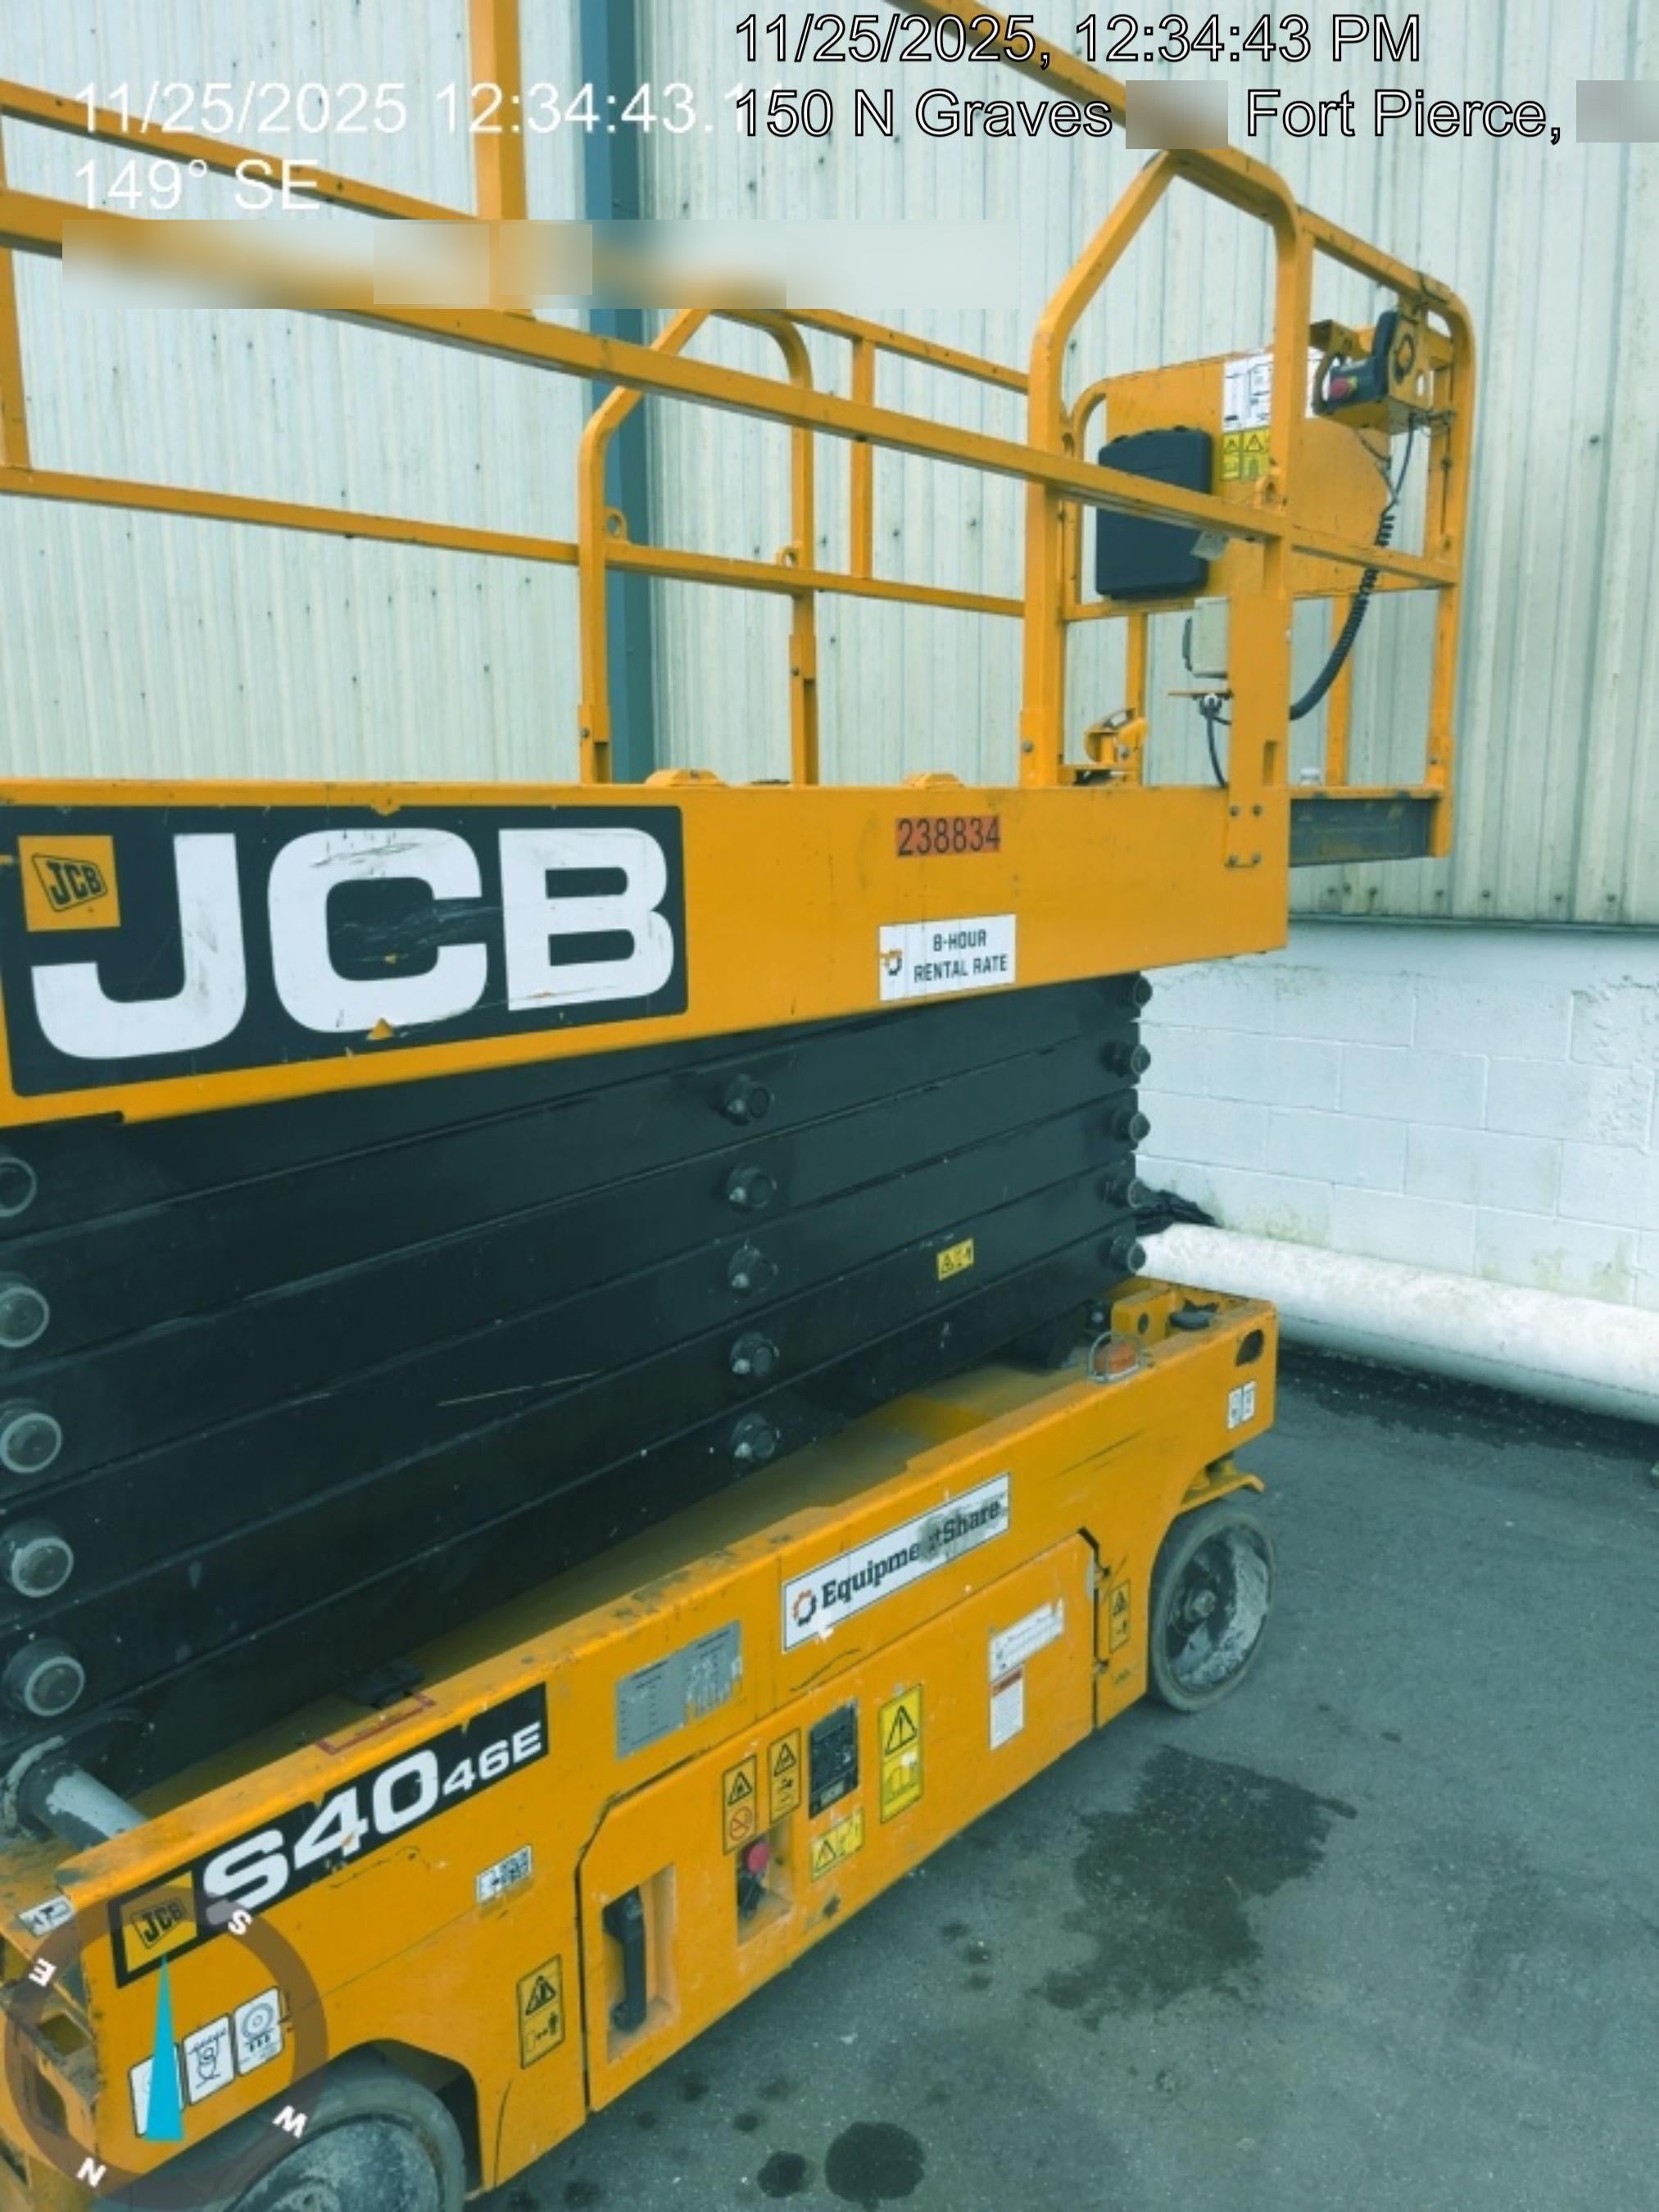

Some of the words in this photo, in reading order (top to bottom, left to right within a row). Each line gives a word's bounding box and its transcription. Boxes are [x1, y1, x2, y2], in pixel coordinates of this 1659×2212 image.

[898, 815, 1001, 856] 238834
[46, 860, 102, 905] JCB
[31, 827, 675, 1060] JCB
[933, 929, 987, 952] 8-HOUR
[913, 959, 968, 983] RENTAL
[972, 954, 1009, 973] RATE
[821, 1500, 1002, 1608] EquipmetShare
[141, 1901, 183, 1942] JCB
